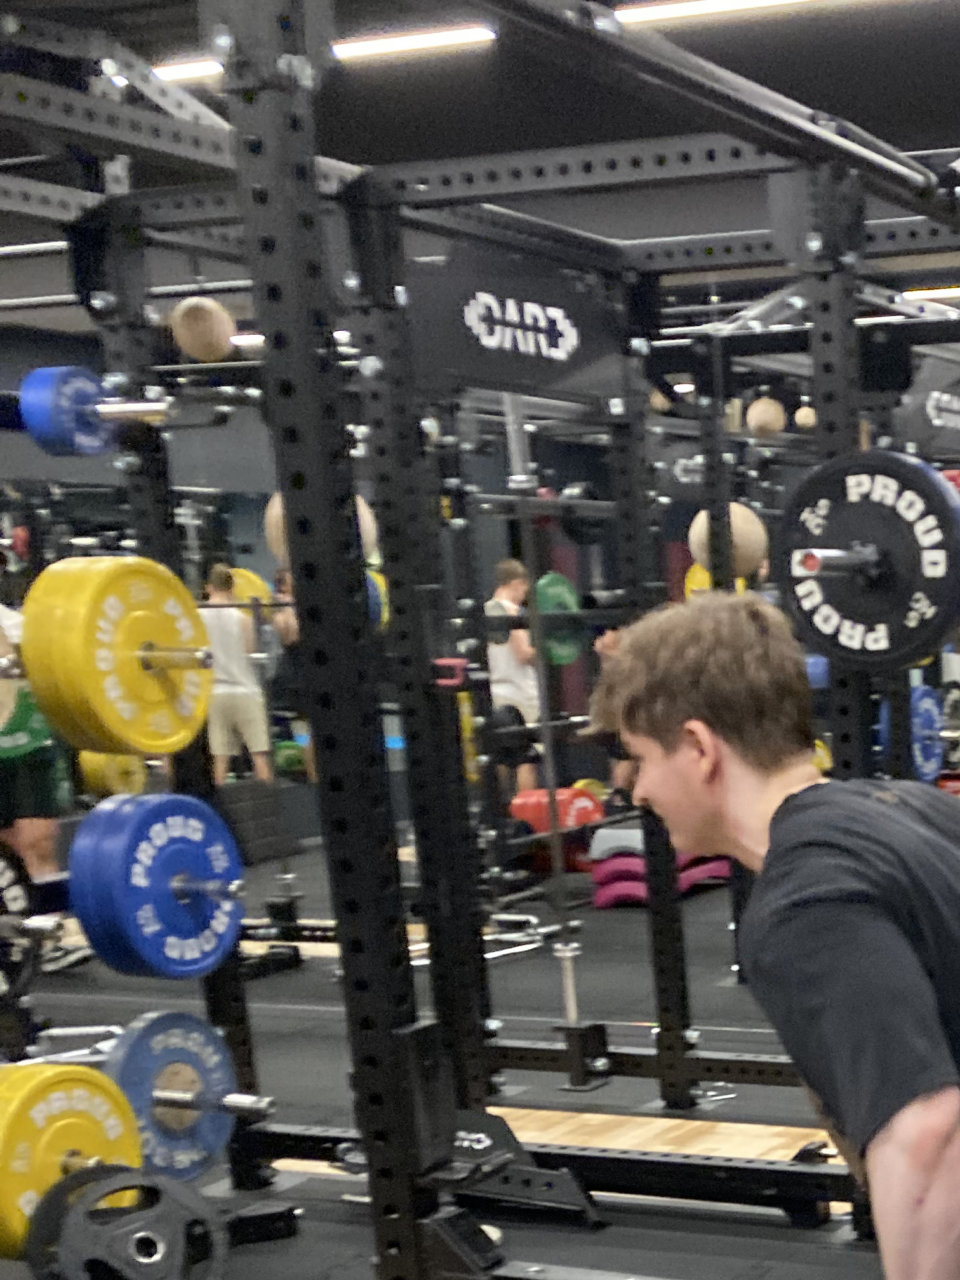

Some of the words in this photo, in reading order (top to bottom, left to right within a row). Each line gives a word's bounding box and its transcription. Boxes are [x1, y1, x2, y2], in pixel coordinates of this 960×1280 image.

[845, 474, 947, 578] PROUD
[791, 549, 890, 651] PROUD
[163, 597, 201, 719] PRUD
[131, 815, 206, 888] PROUD
[29, 1087, 124, 1141] PROUD
